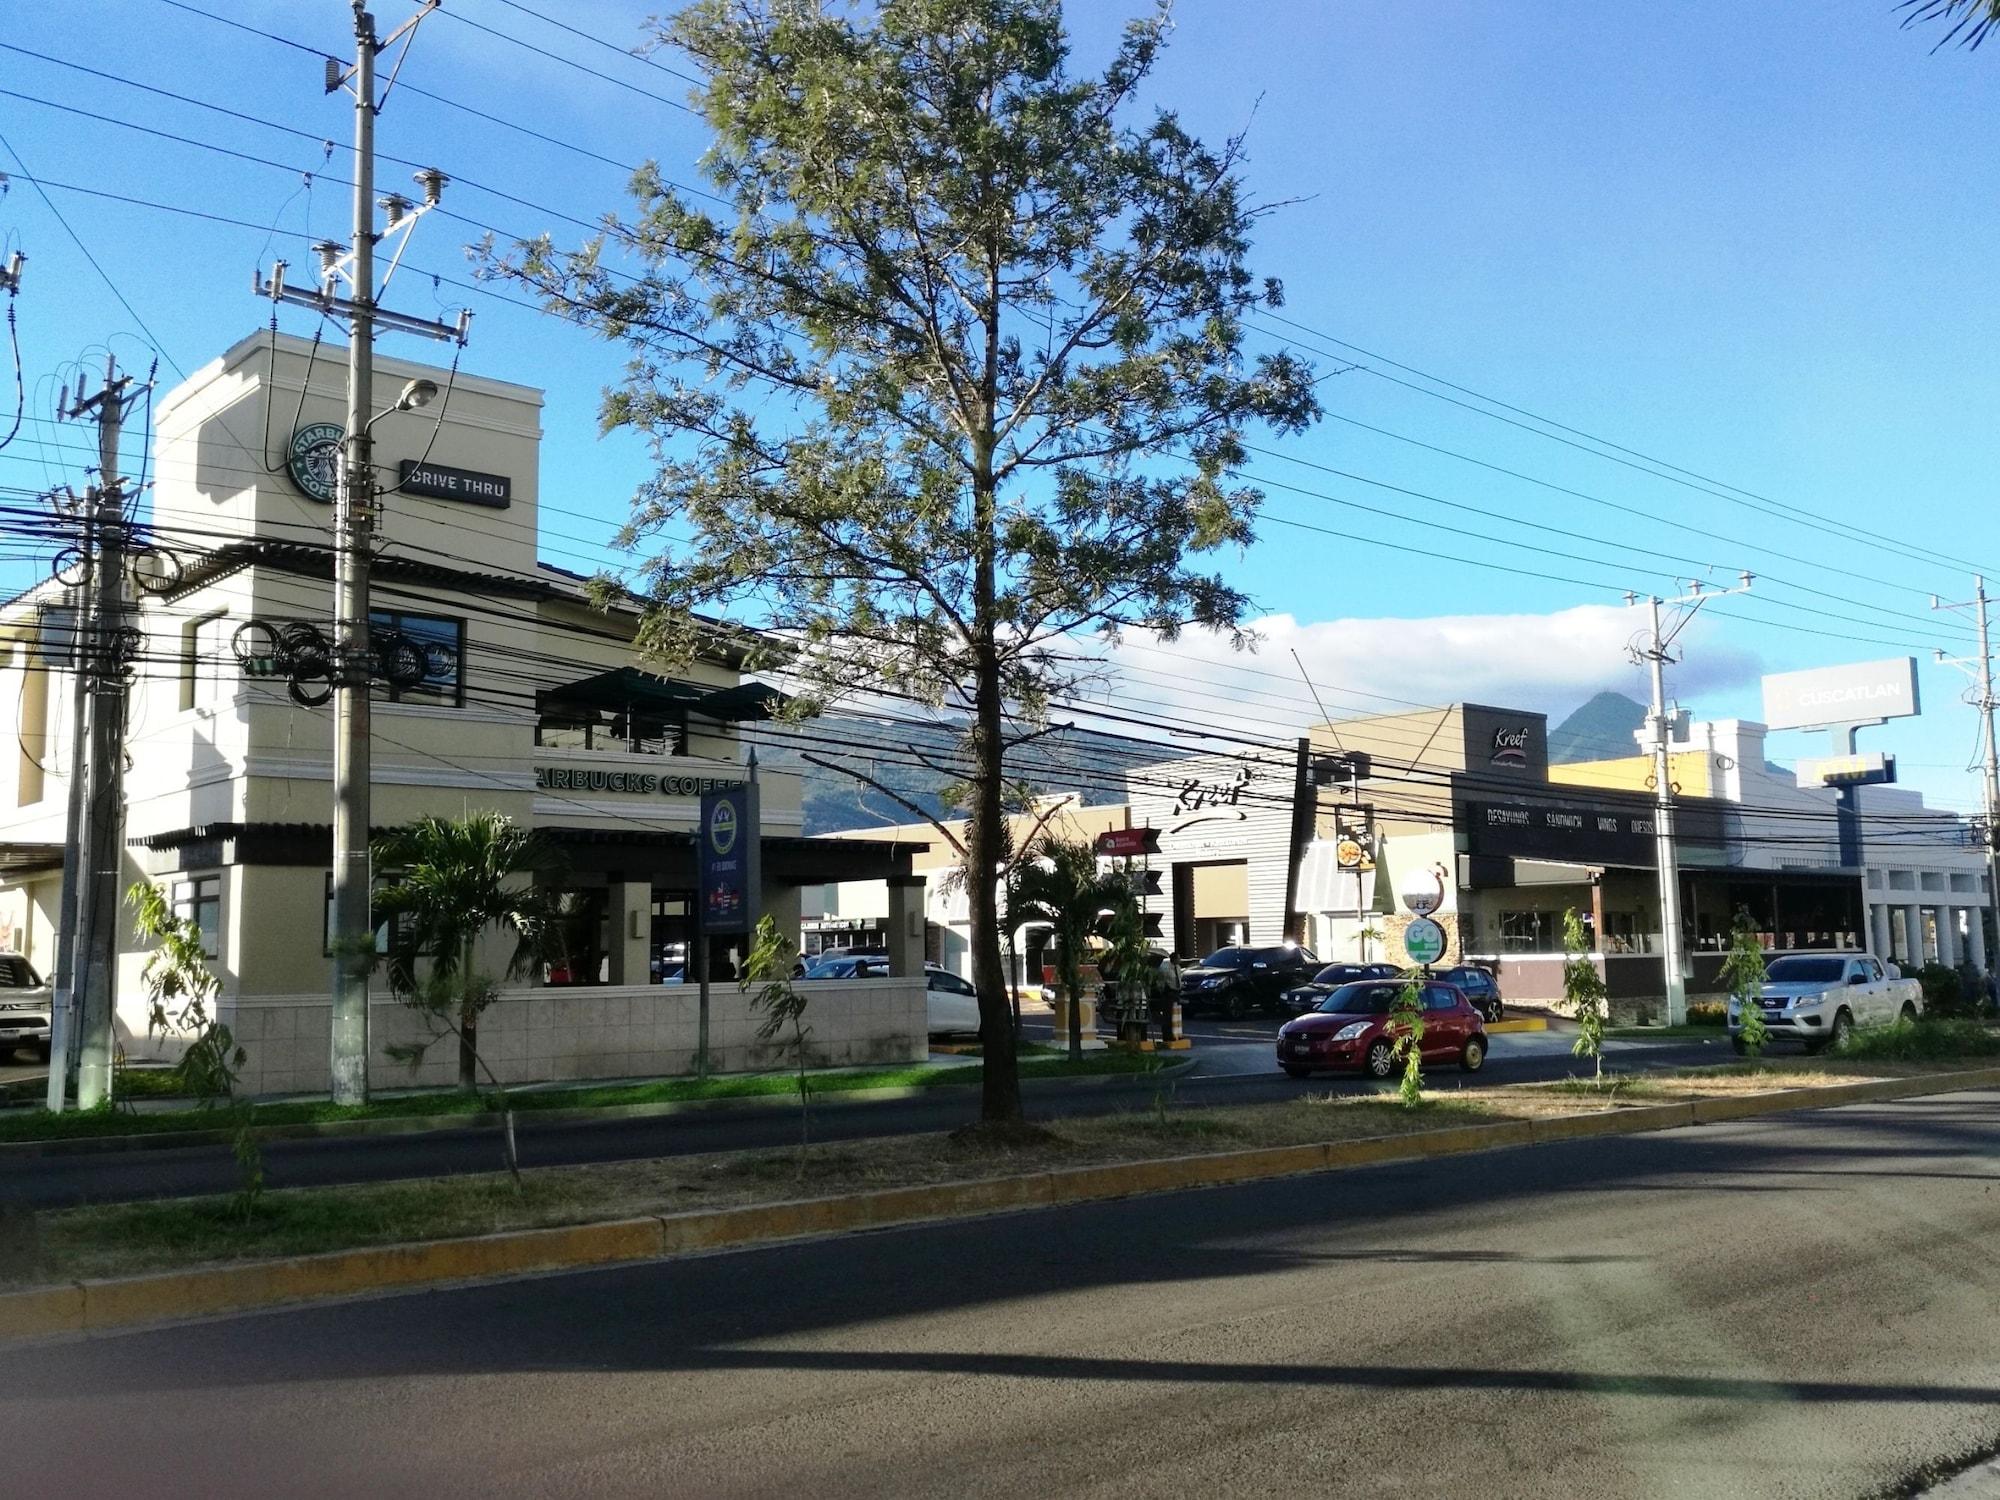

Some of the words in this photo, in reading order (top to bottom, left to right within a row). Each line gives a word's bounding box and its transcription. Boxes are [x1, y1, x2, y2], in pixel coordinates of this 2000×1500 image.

[411, 468, 457, 490] DRIVE
[463, 478, 505, 498] THRU
[1494, 727, 1528, 749] Kreef
